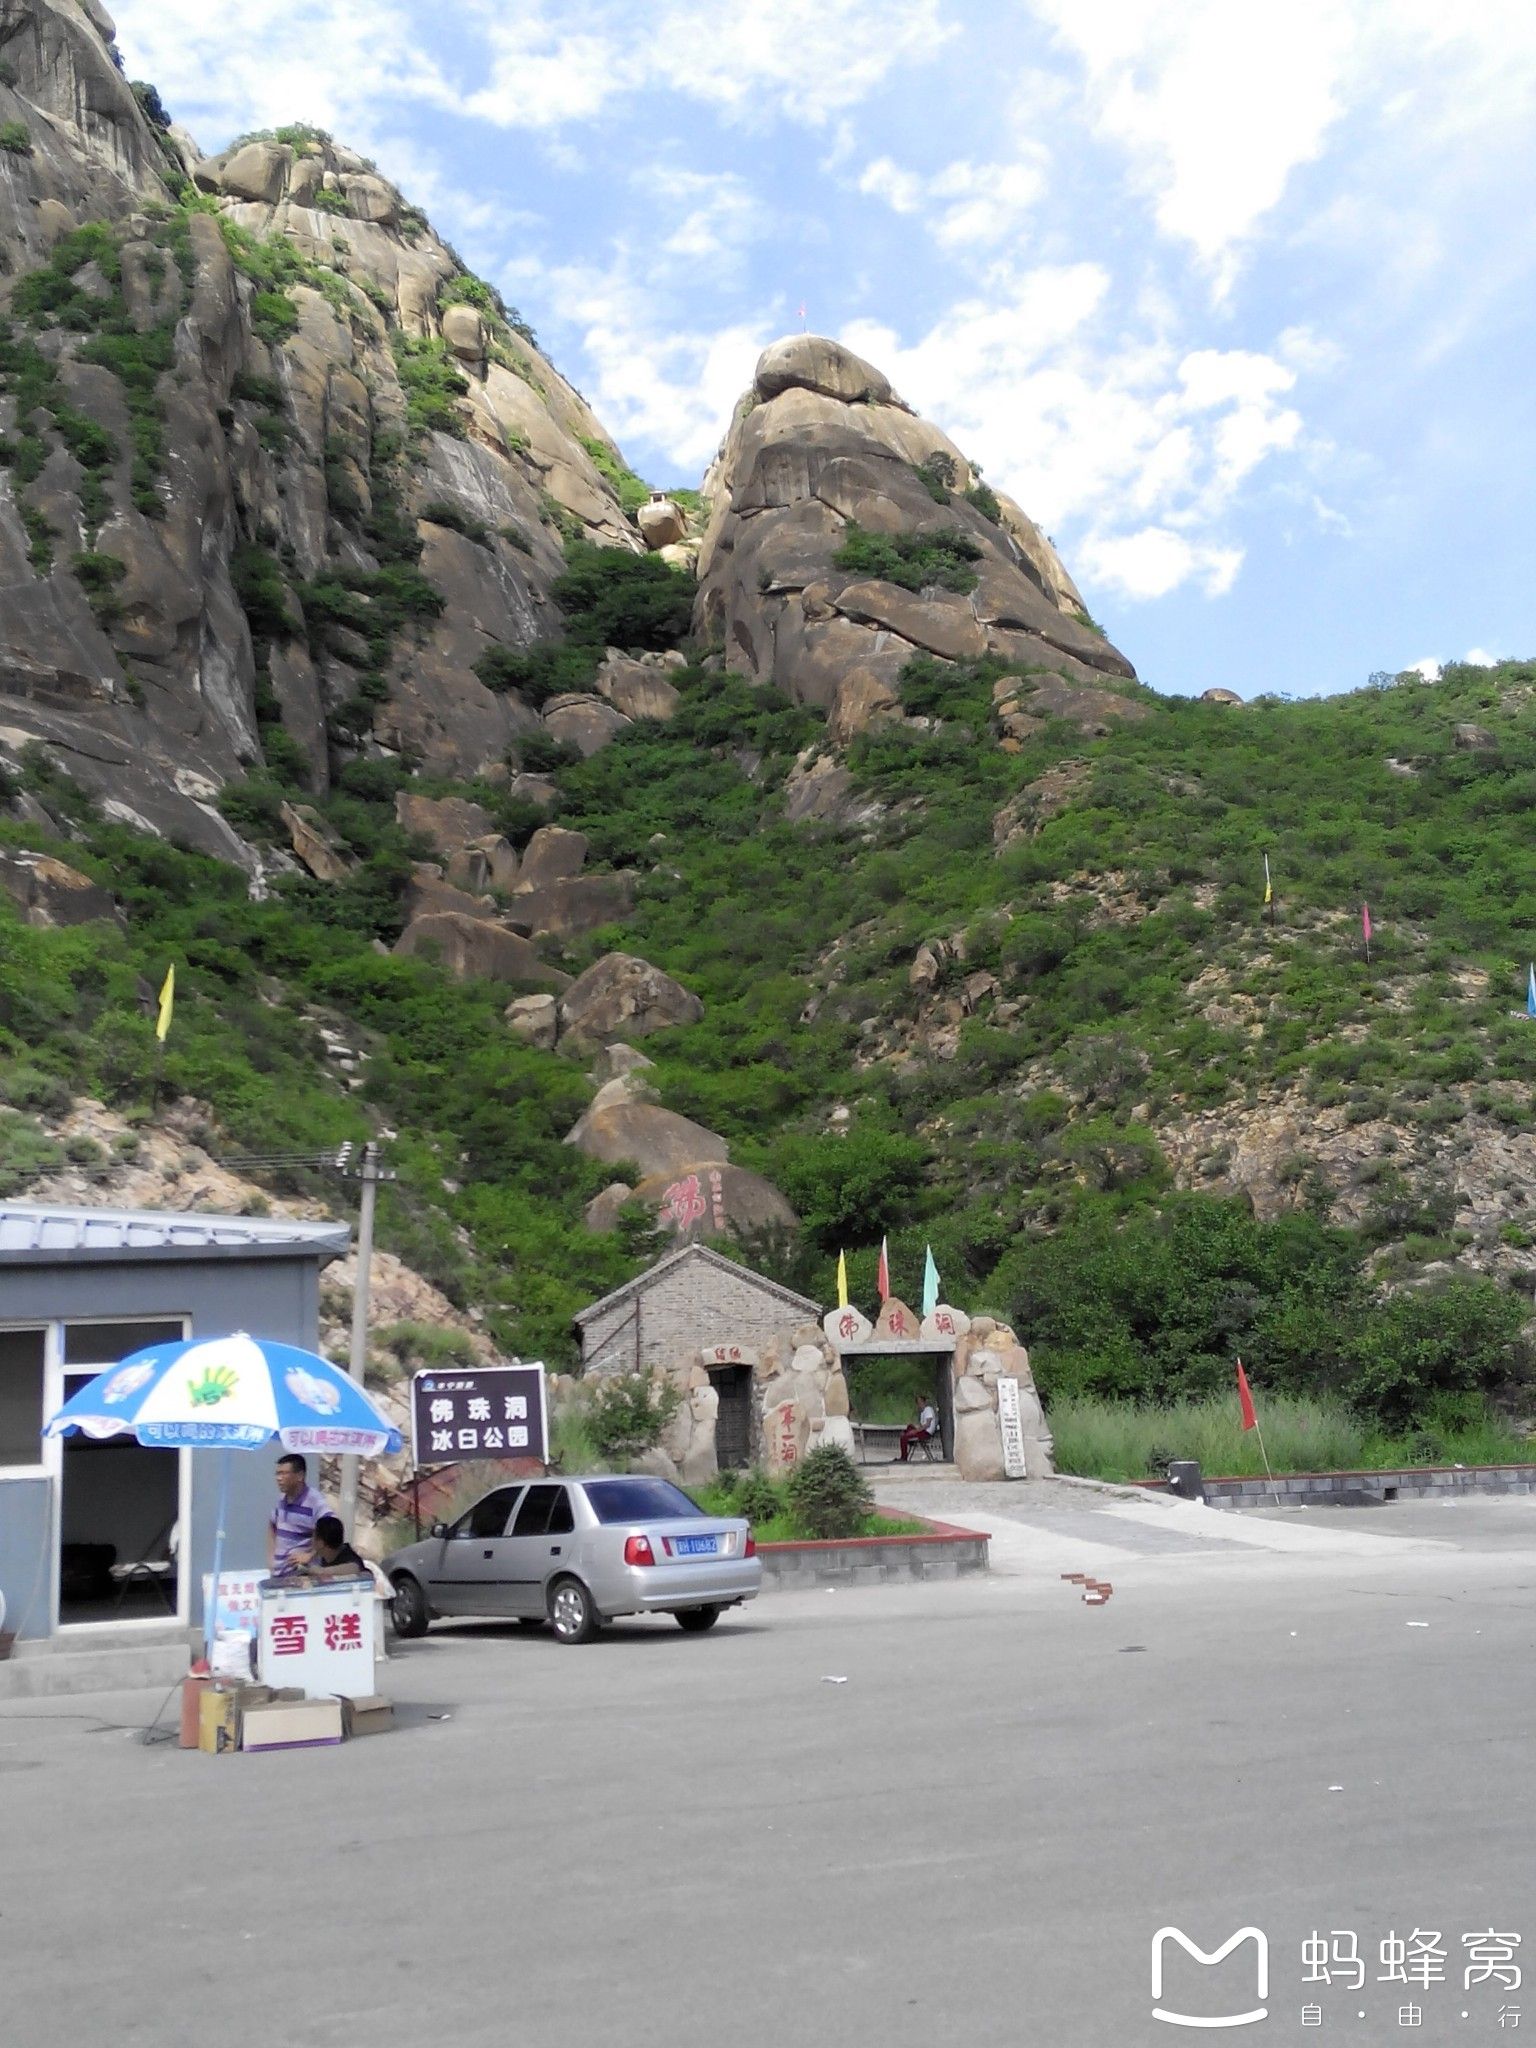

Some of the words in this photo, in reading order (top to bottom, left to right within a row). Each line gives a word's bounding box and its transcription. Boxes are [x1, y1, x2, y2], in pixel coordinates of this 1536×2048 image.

[660, 1174, 706, 1231] 佛
[839, 1310, 955, 1341] 佛珠洞
[429, 1396, 528, 1423] 佛珠洞
[271, 1614, 362, 1656] 雪糕
